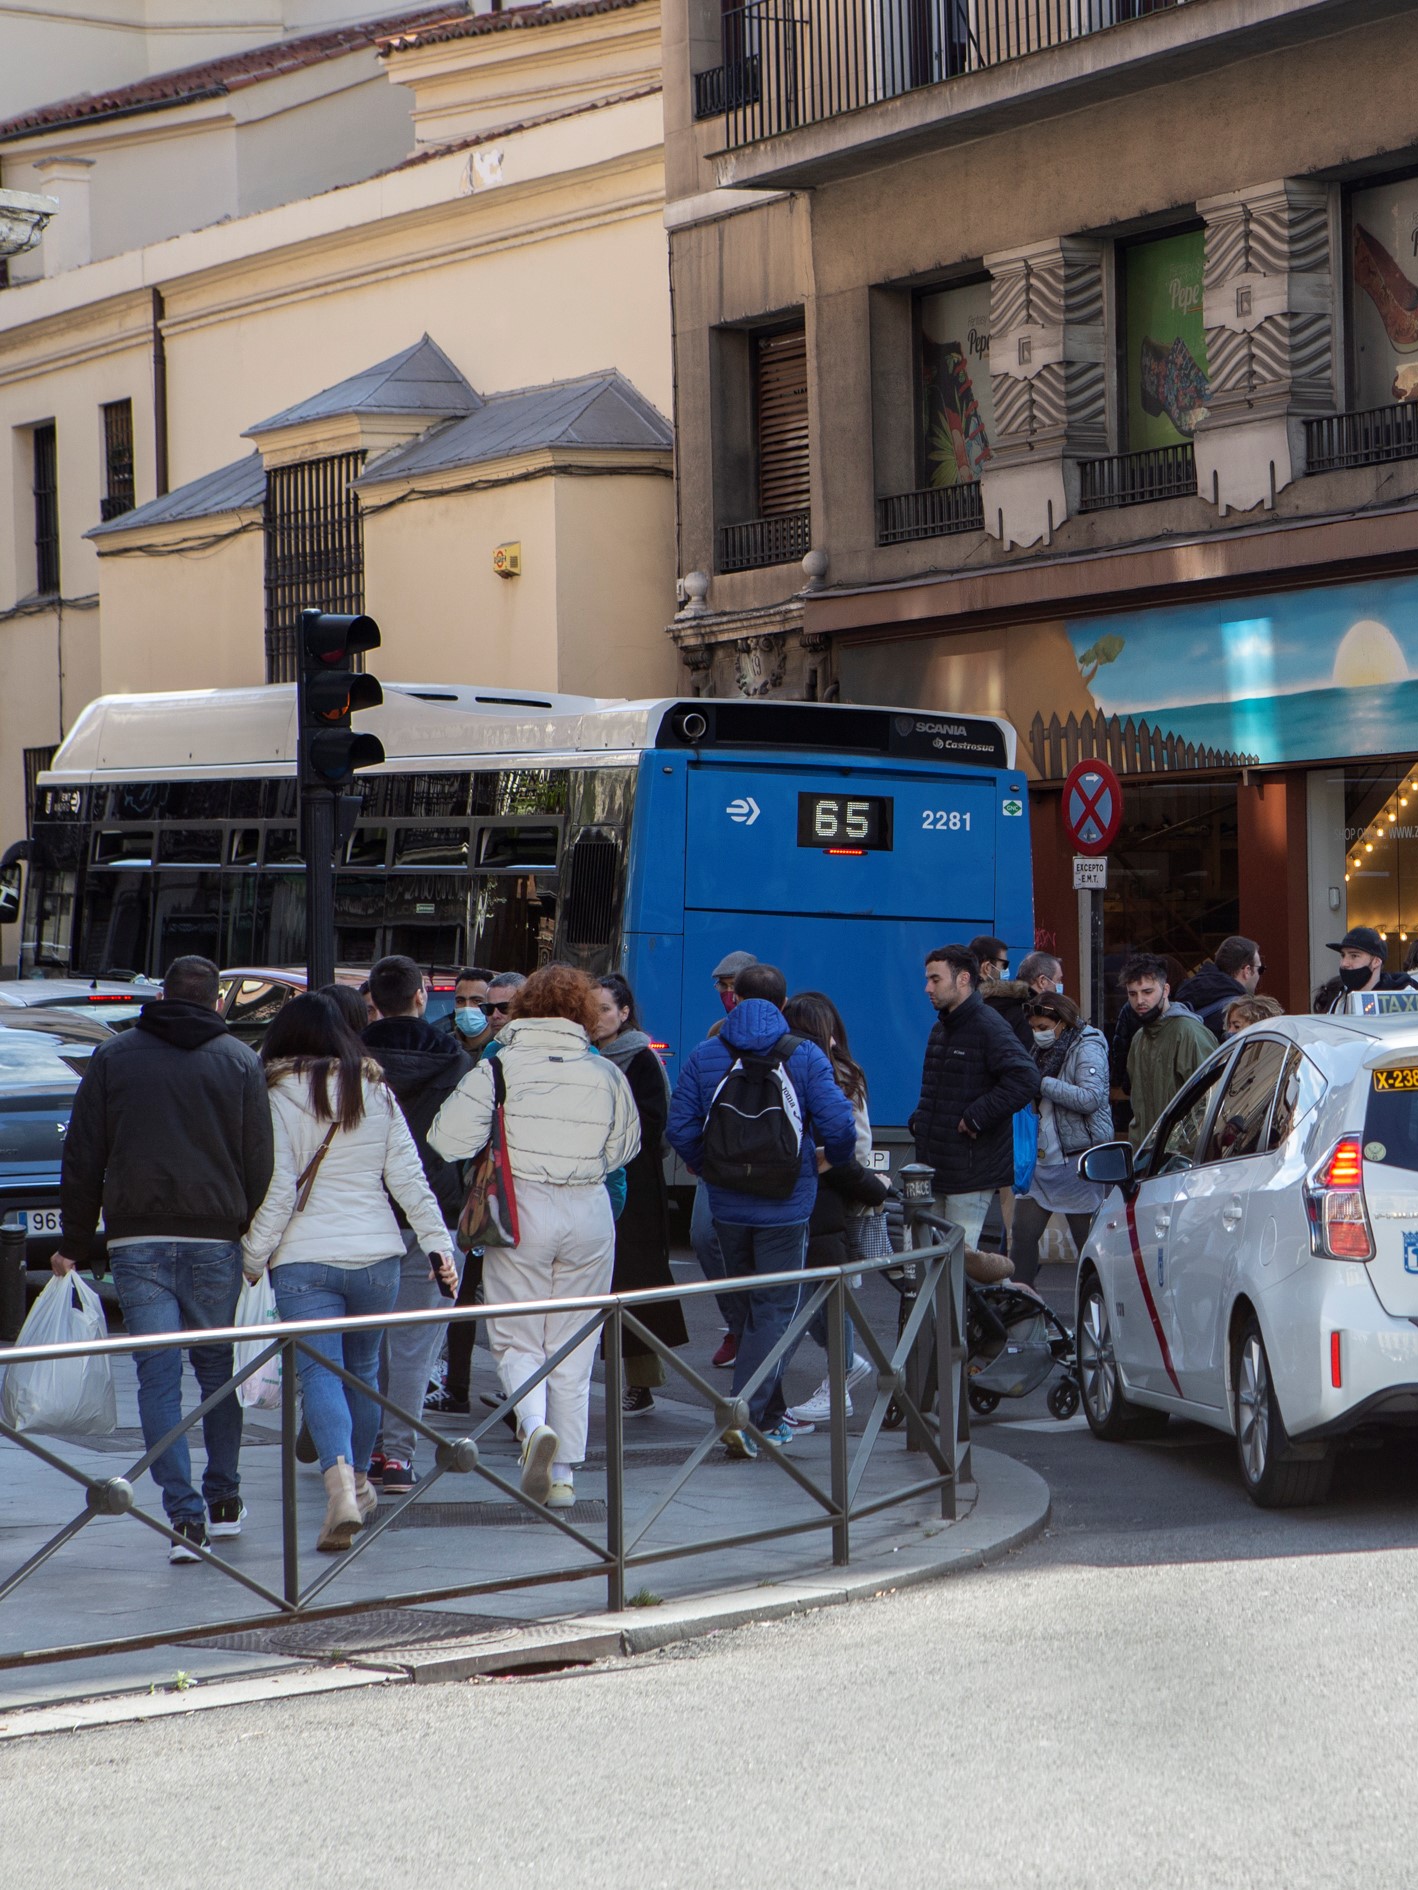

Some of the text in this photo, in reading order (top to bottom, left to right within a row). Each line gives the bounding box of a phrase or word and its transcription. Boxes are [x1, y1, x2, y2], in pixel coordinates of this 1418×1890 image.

[1169, 278, 1199, 315] Pepe
[916, 721, 967, 736] SCANIA
[945, 739, 995, 752] Castrosua
[815, 800, 870, 838] 65
[922, 810, 971, 832] 2281
[1076, 864, 1104, 872] EXCEPTO
[33, 1213, 62, 1230] 96
